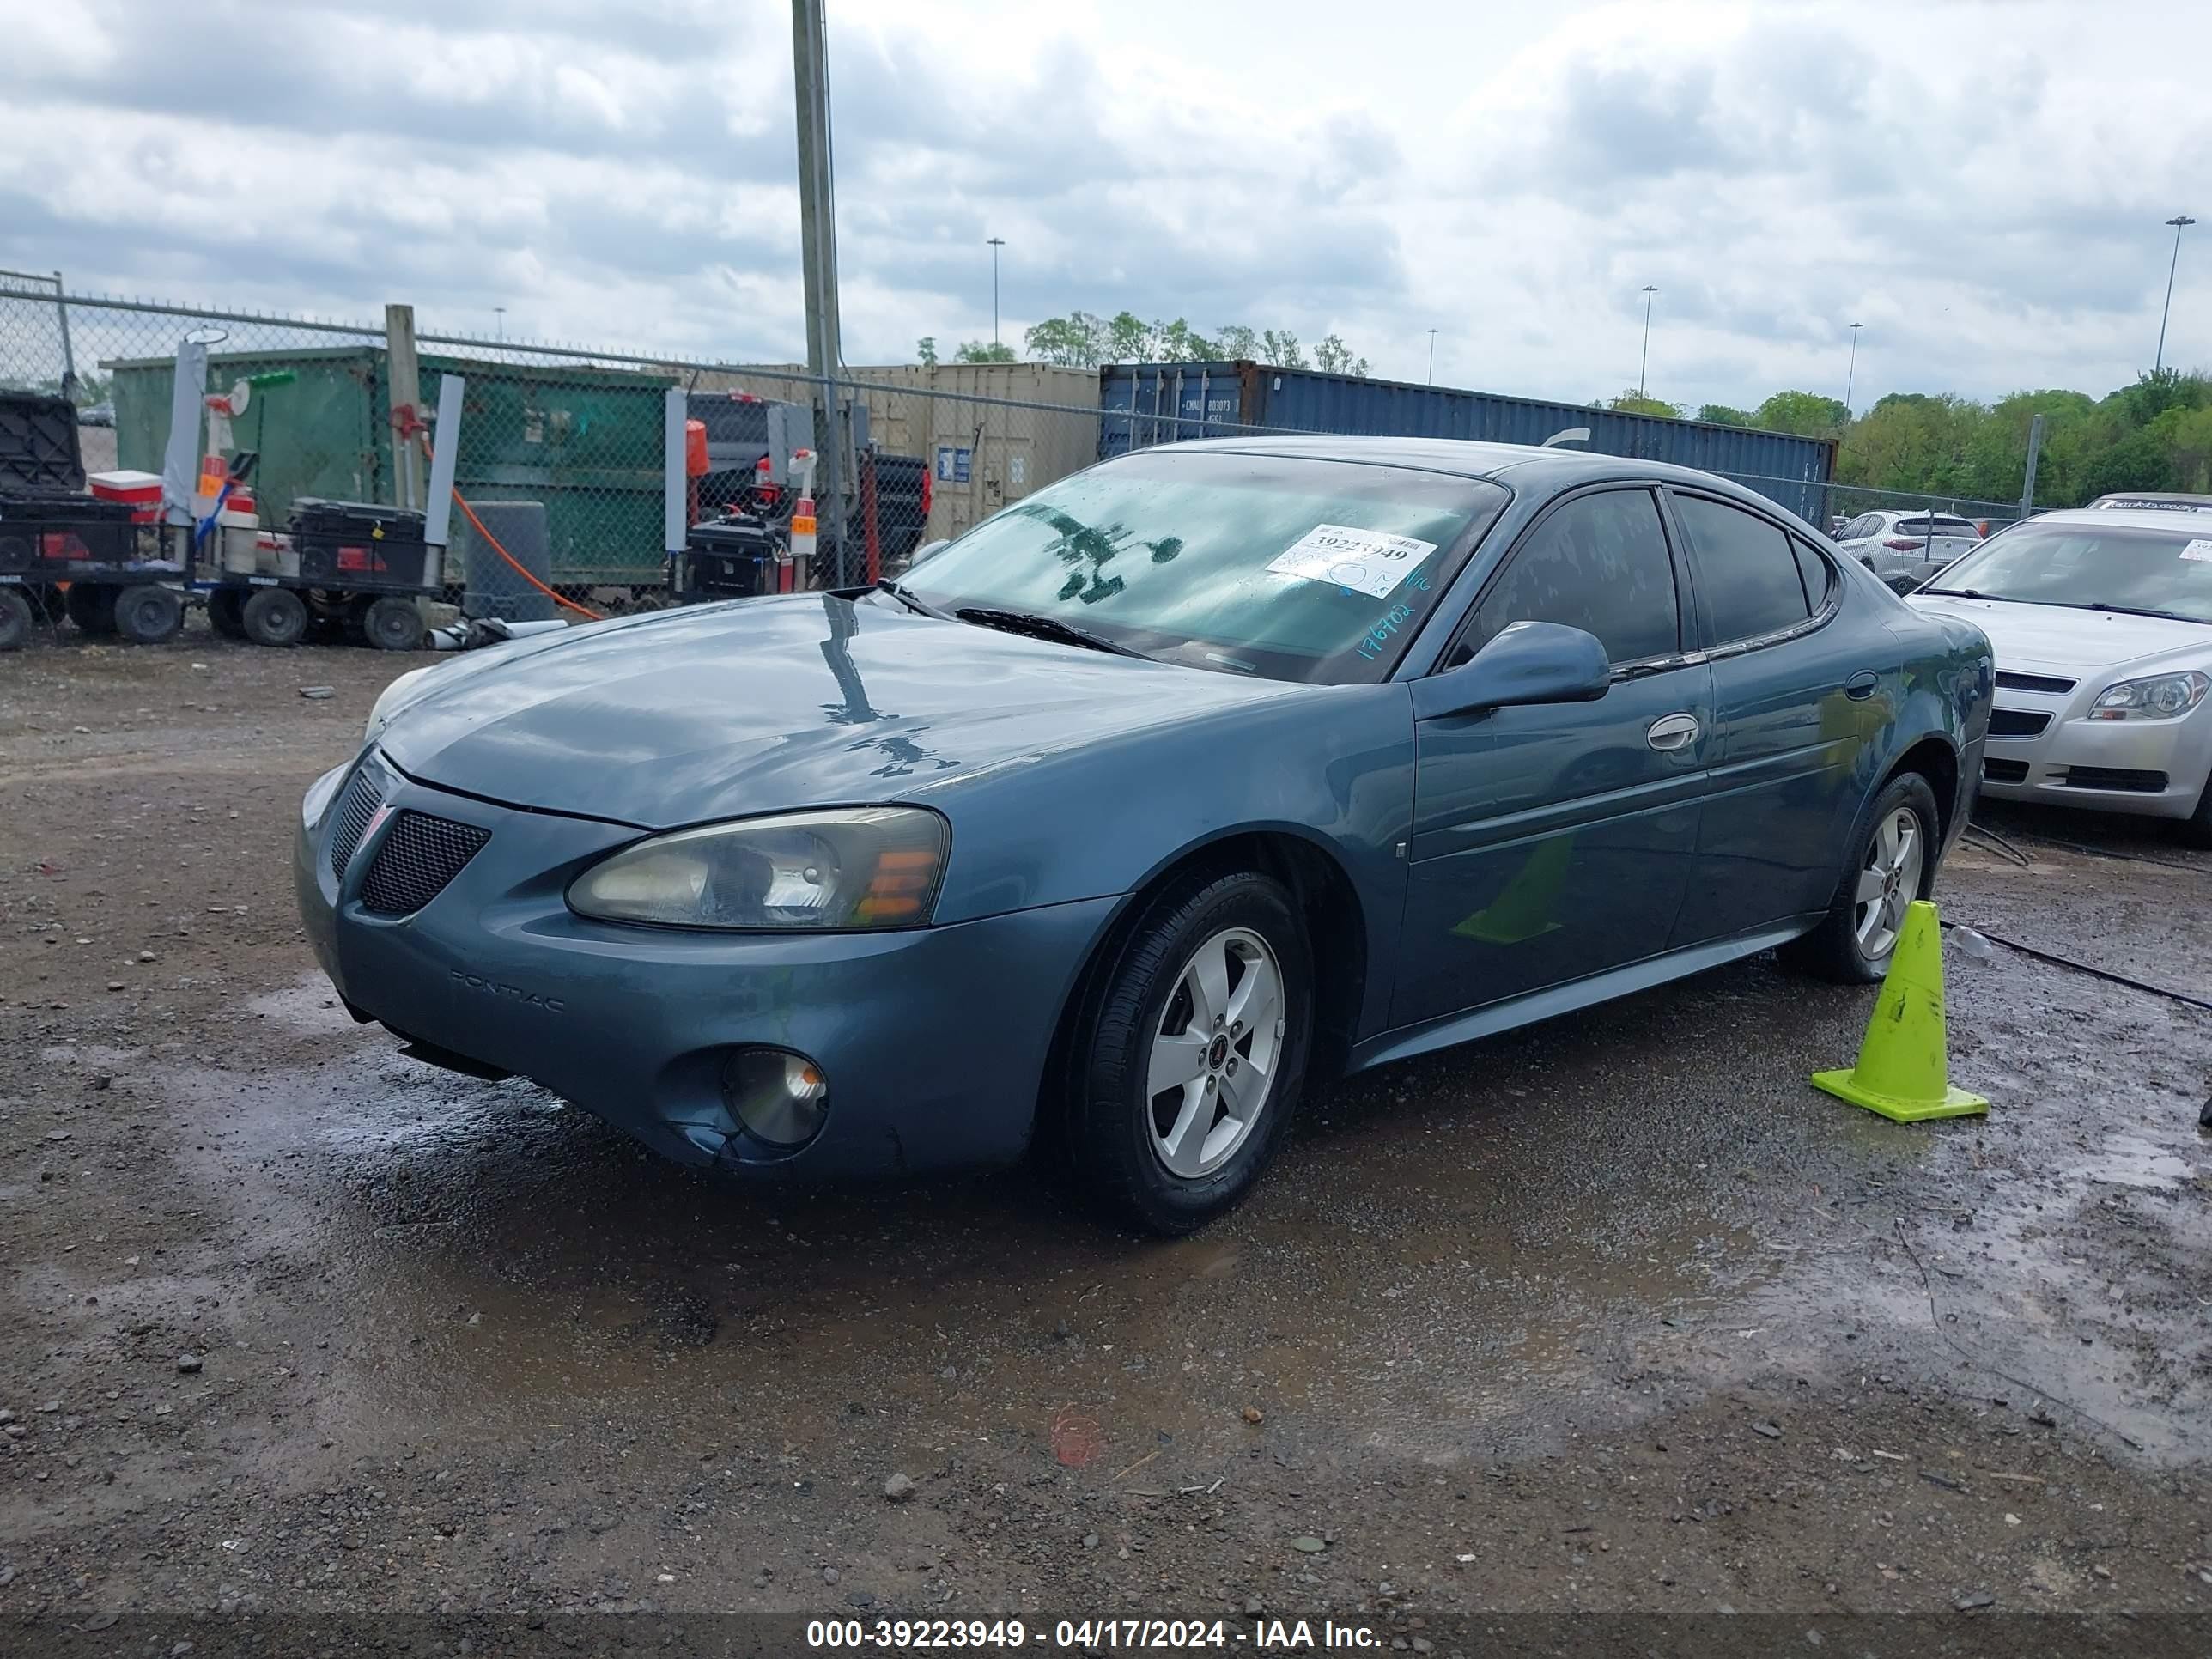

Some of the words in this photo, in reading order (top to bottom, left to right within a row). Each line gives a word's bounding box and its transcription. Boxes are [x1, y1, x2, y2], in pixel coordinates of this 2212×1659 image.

[1310, 536, 1408, 561] 39223949
[1357, 604, 1415, 659] 176702
[449, 968, 564, 1013] PONTIAC
